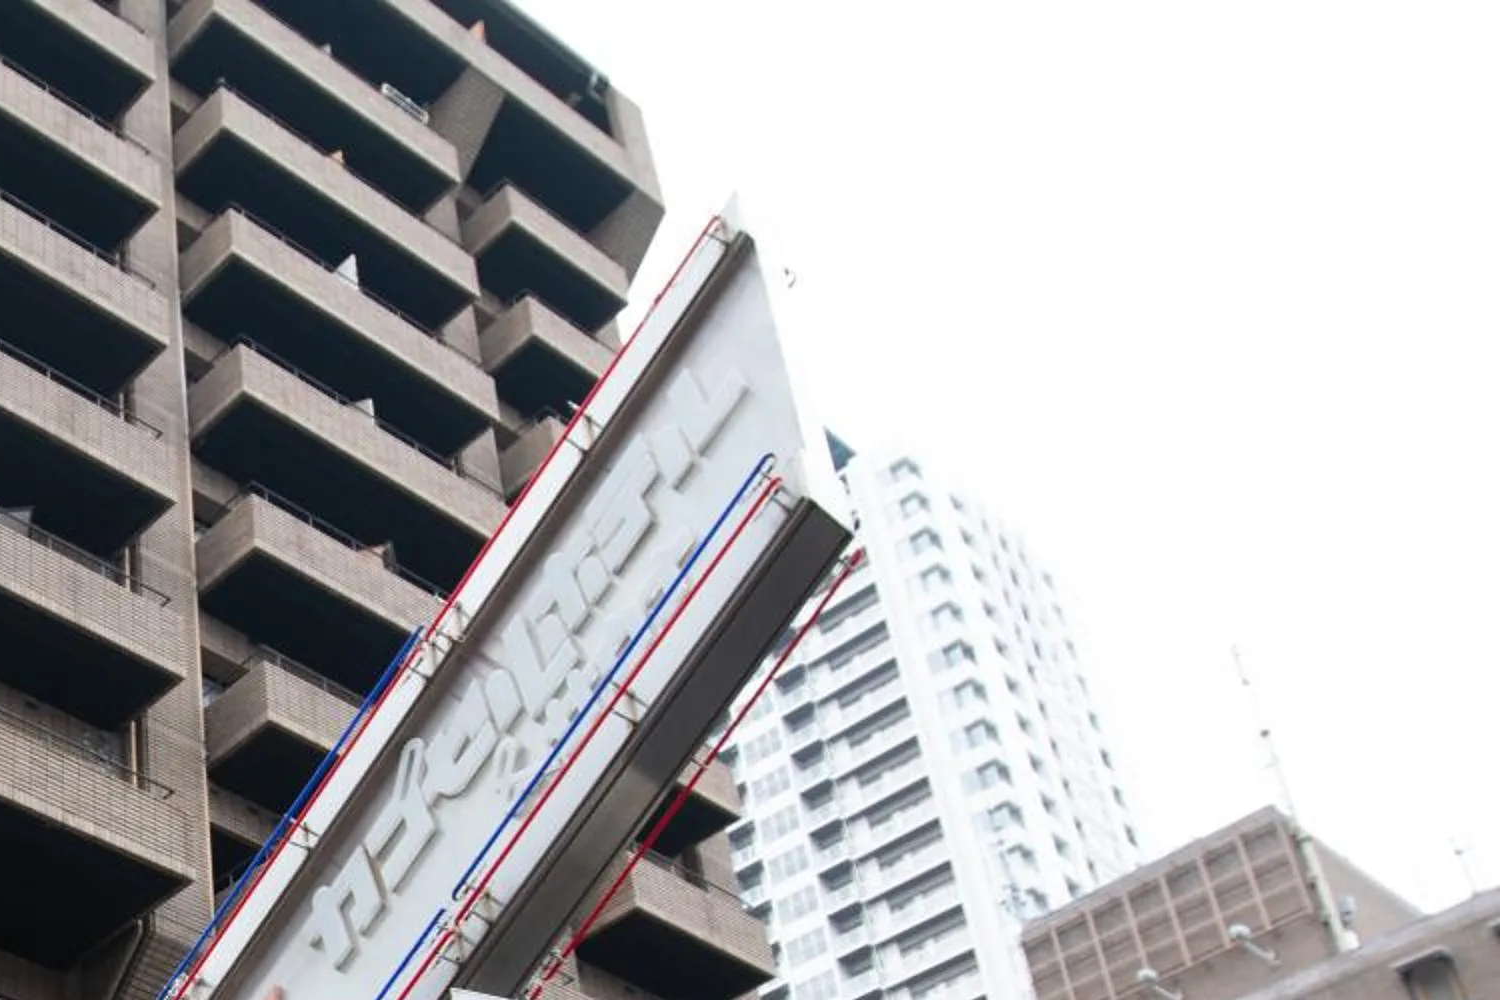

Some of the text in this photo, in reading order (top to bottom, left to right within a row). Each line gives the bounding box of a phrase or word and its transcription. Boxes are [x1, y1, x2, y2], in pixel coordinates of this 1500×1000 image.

[311, 368, 751, 970] カプセルホテル
